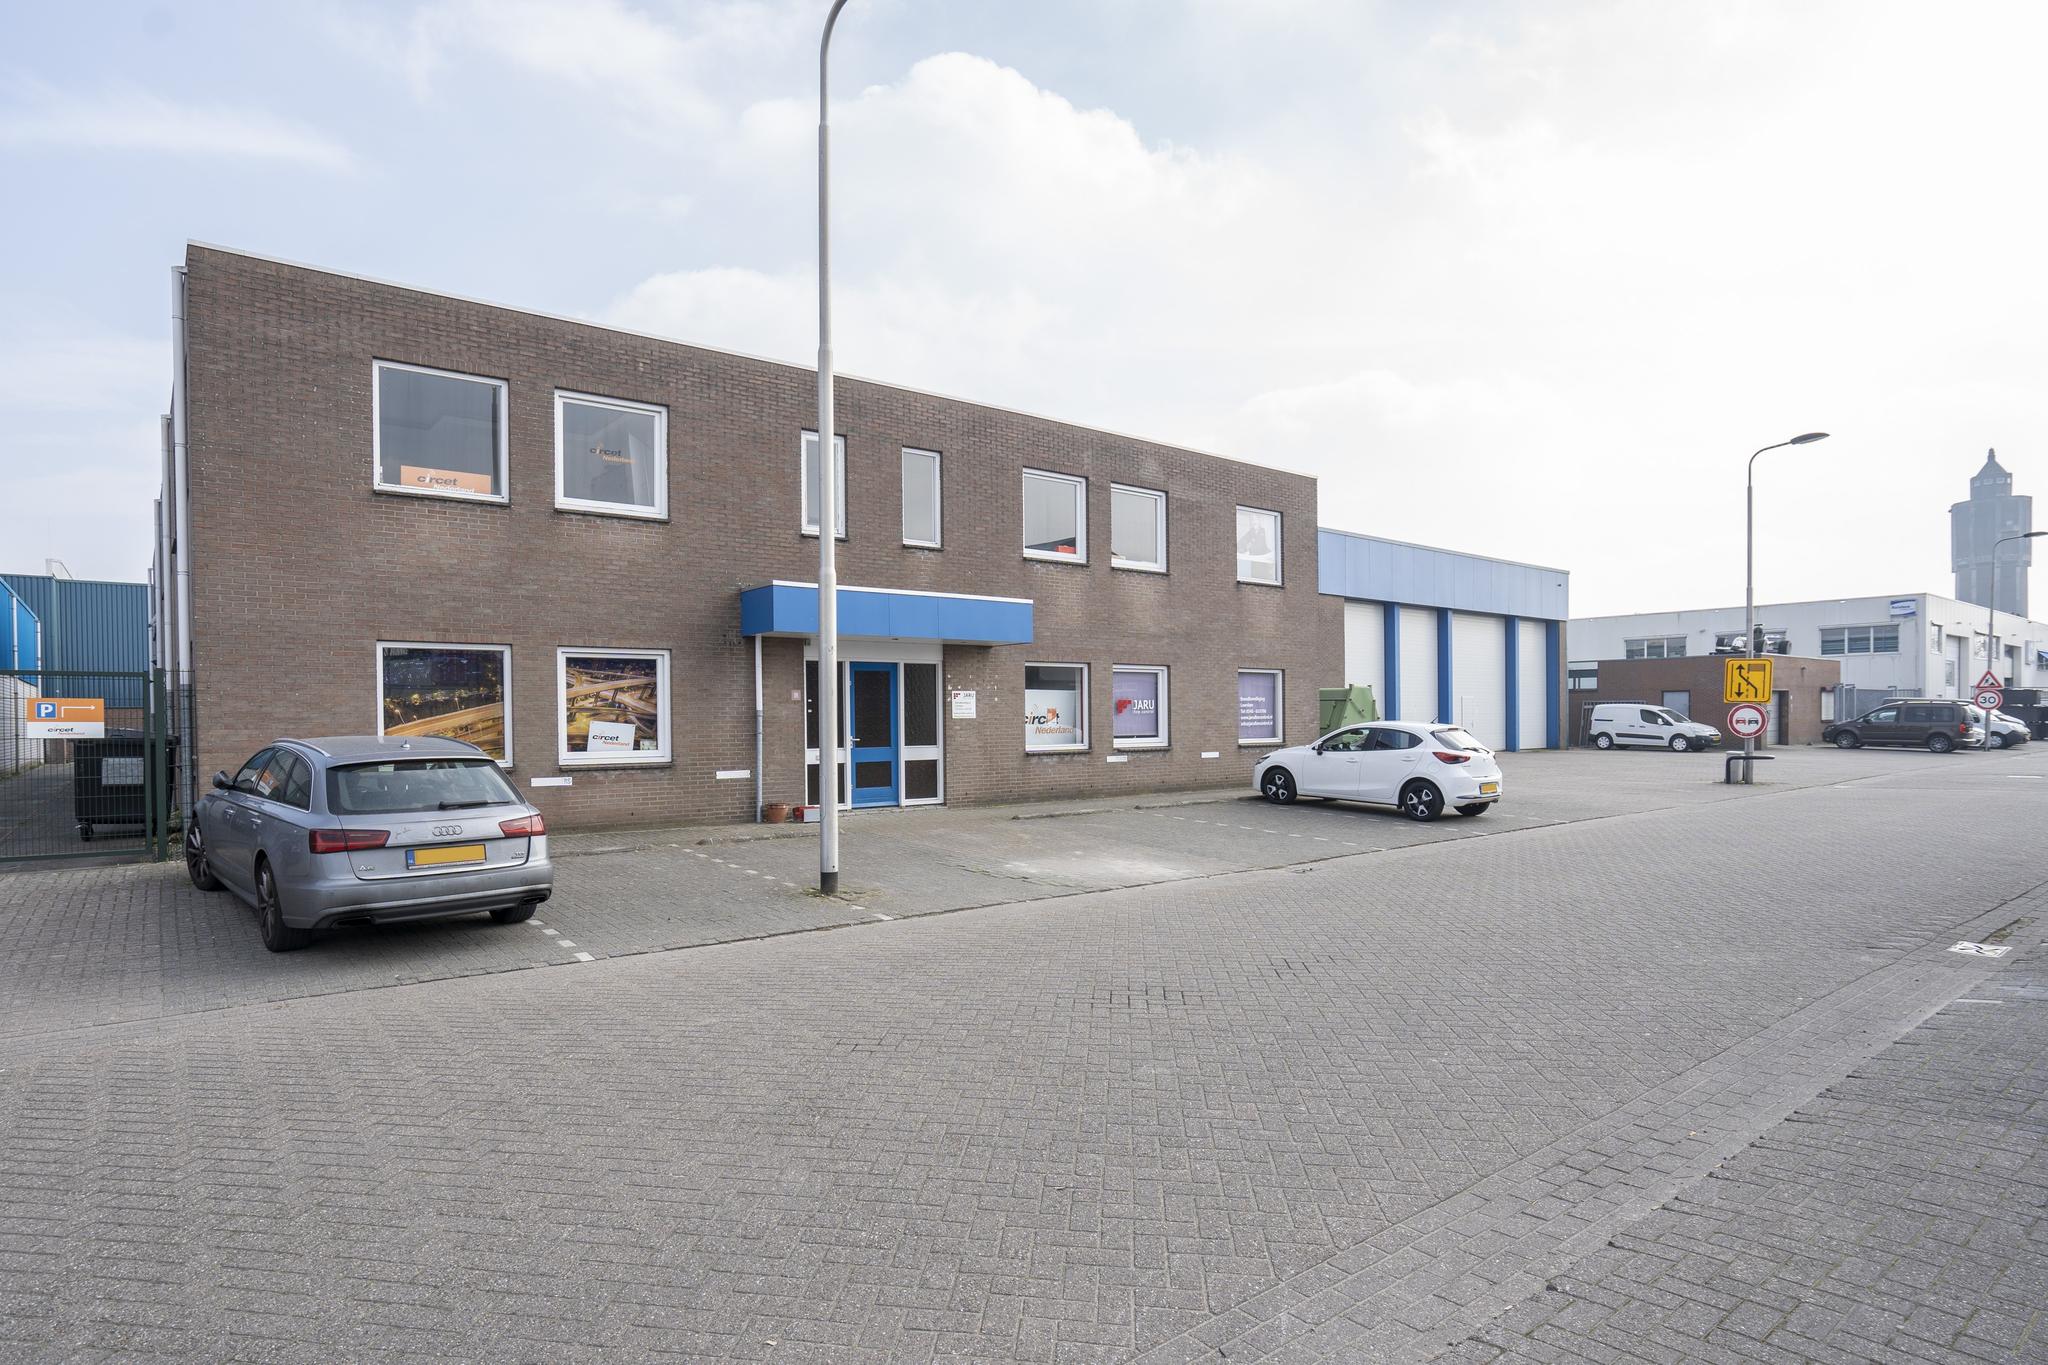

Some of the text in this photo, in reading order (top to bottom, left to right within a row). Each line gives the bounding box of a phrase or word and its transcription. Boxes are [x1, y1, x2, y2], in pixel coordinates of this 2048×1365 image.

[416, 473, 458, 485] circet
[1132, 699, 1155, 710] JARU
[1980, 696, 1997, 704] 30
[40, 703, 54, 718] P
[592, 734, 619, 742] circet
